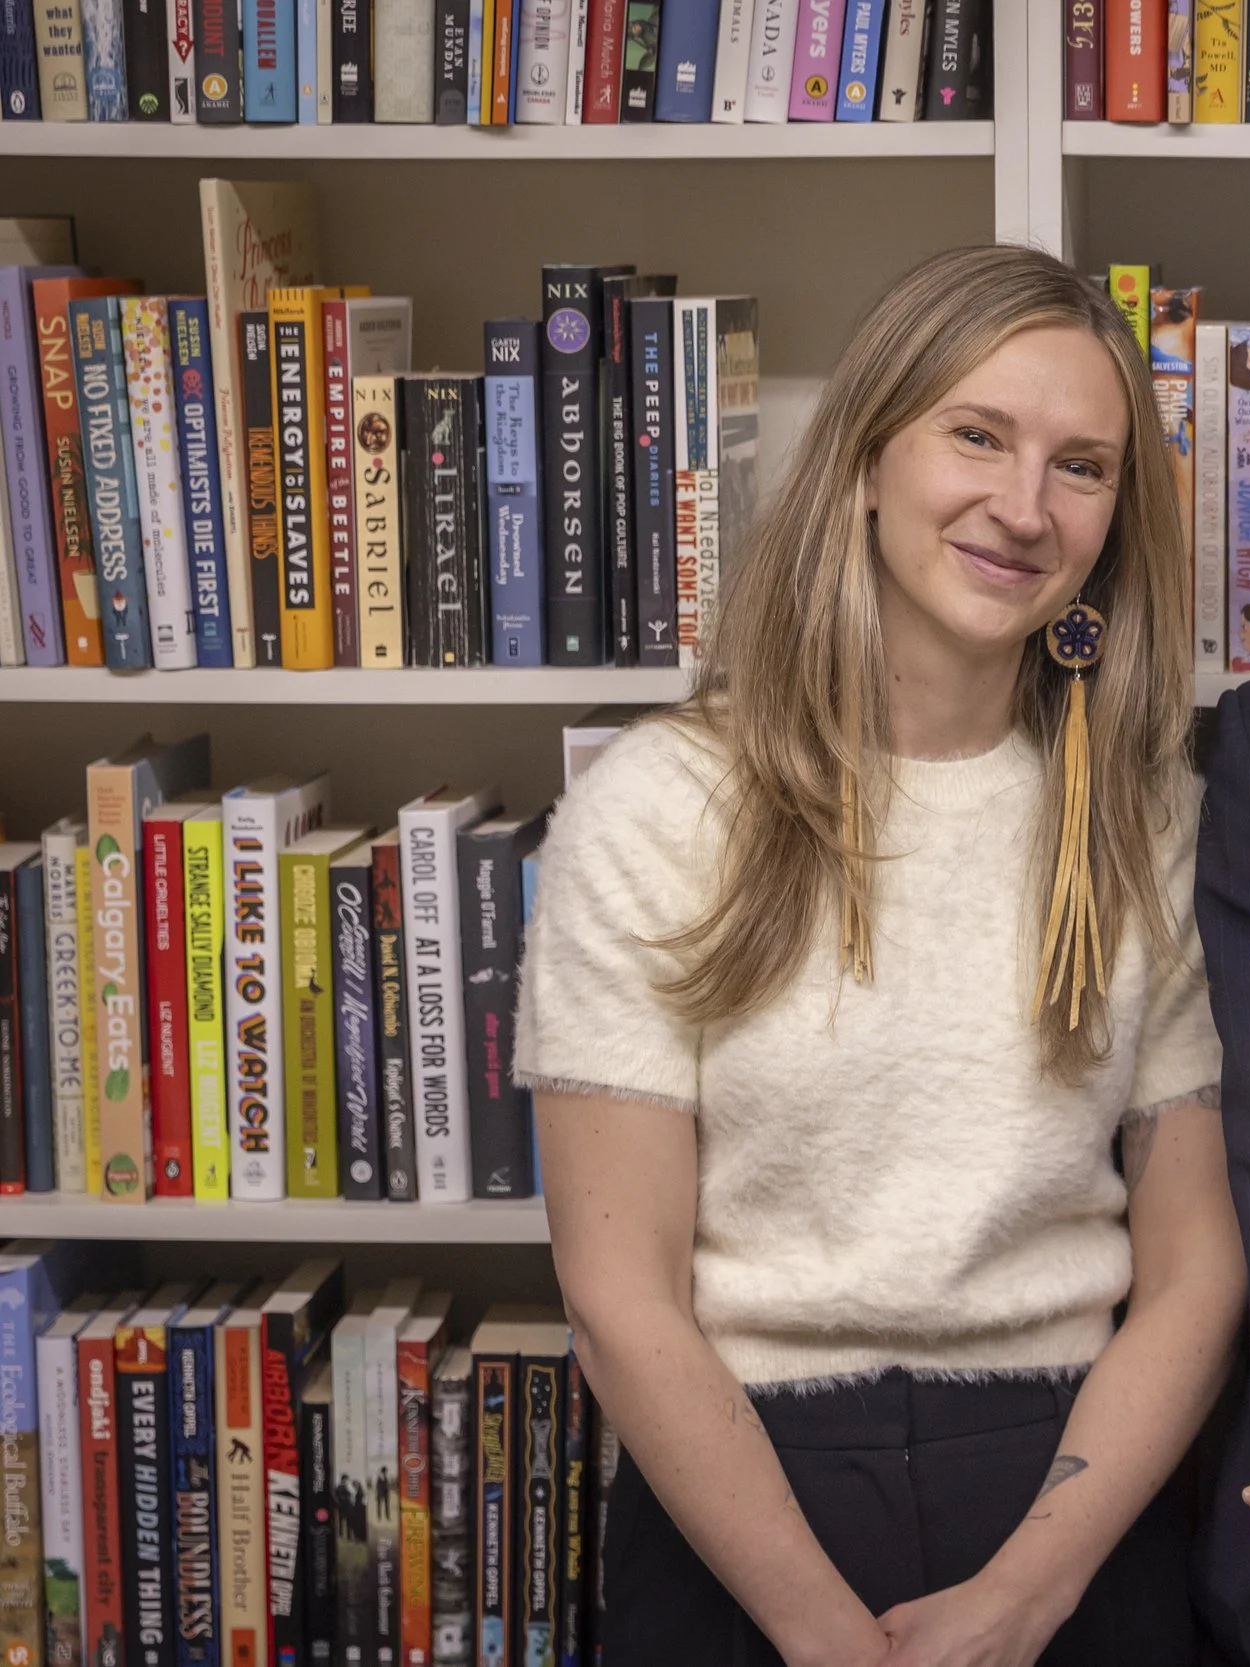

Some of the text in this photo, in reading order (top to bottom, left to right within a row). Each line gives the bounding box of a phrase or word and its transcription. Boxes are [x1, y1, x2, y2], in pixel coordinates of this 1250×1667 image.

[46, 7, 72, 19] what
[49, 25, 72, 40] they
[535, 2, 549, 50] OPINION
[850, 3, 871, 74] PAUL MYERS
[942, 21, 958, 71] MYLES
[1210, 38, 1224, 48] Tia
[43, 41, 82, 57] wanted
[445, 14, 454, 81] MUNDAY
[454, 28, 464, 68] EVAN
[1210, 62, 1227, 72] MD
[548, 284, 587, 298] NIX
[40, 317, 72, 410] SNAP
[176, 310, 188, 364] NIELSEN
[188, 318, 200, 357] SUSIN
[491, 338, 520, 349] GARTH
[493, 349, 520, 361] NIX
[281, 344, 303, 469] ENERGY
[328, 366, 346, 469] EMPIRE
[356, 389, 393, 401] NIX
[427, 388, 458, 400] NIX
[612, 397, 623, 418] THE
[645, 333, 659, 505] THE PEEP DIARIES
[613, 421, 624, 439] BIG
[614, 442, 625, 473] BOOK
[57, 437, 79, 557] SUSIN NIELSEN
[83, 364, 127, 582] NO FIXED ADDRESS
[147, 473, 158, 505] made
[248, 427, 277, 559] TREMENDOUS THINGS
[616, 493, 627, 516] POP
[184, 404, 219, 617] OPTIMISTS DIE FIRST
[617, 518, 628, 568] CULTURE
[151, 530, 166, 597] molecules
[286, 496, 308, 604] SLAVES
[332, 496, 349, 595] BEETLE
[677, 470, 698, 646] WE WANT SOME TOO
[97, 851, 129, 986] Calgary
[154, 834, 173, 1077] LITTLE CRUELTIES LIZ NUGENT
[410, 828, 450, 1137] CAROL OFF AT A LOSS FOR WORDS
[188, 847, 221, 1147] STRANGE SALLY DIAMOND LIZ NUGENT
[233, 837, 269, 1153] I LIKE TO WATCH
[104, 994, 133, 1071] Eats
[266, 1349, 297, 1471] AIRBORN
[89, 1360, 114, 1608] ondjaki transparent city
[132, 1381, 162, 1644] EVERY HIDDEN THING
[176, 1491, 212, 1640] BOUNDLESS
